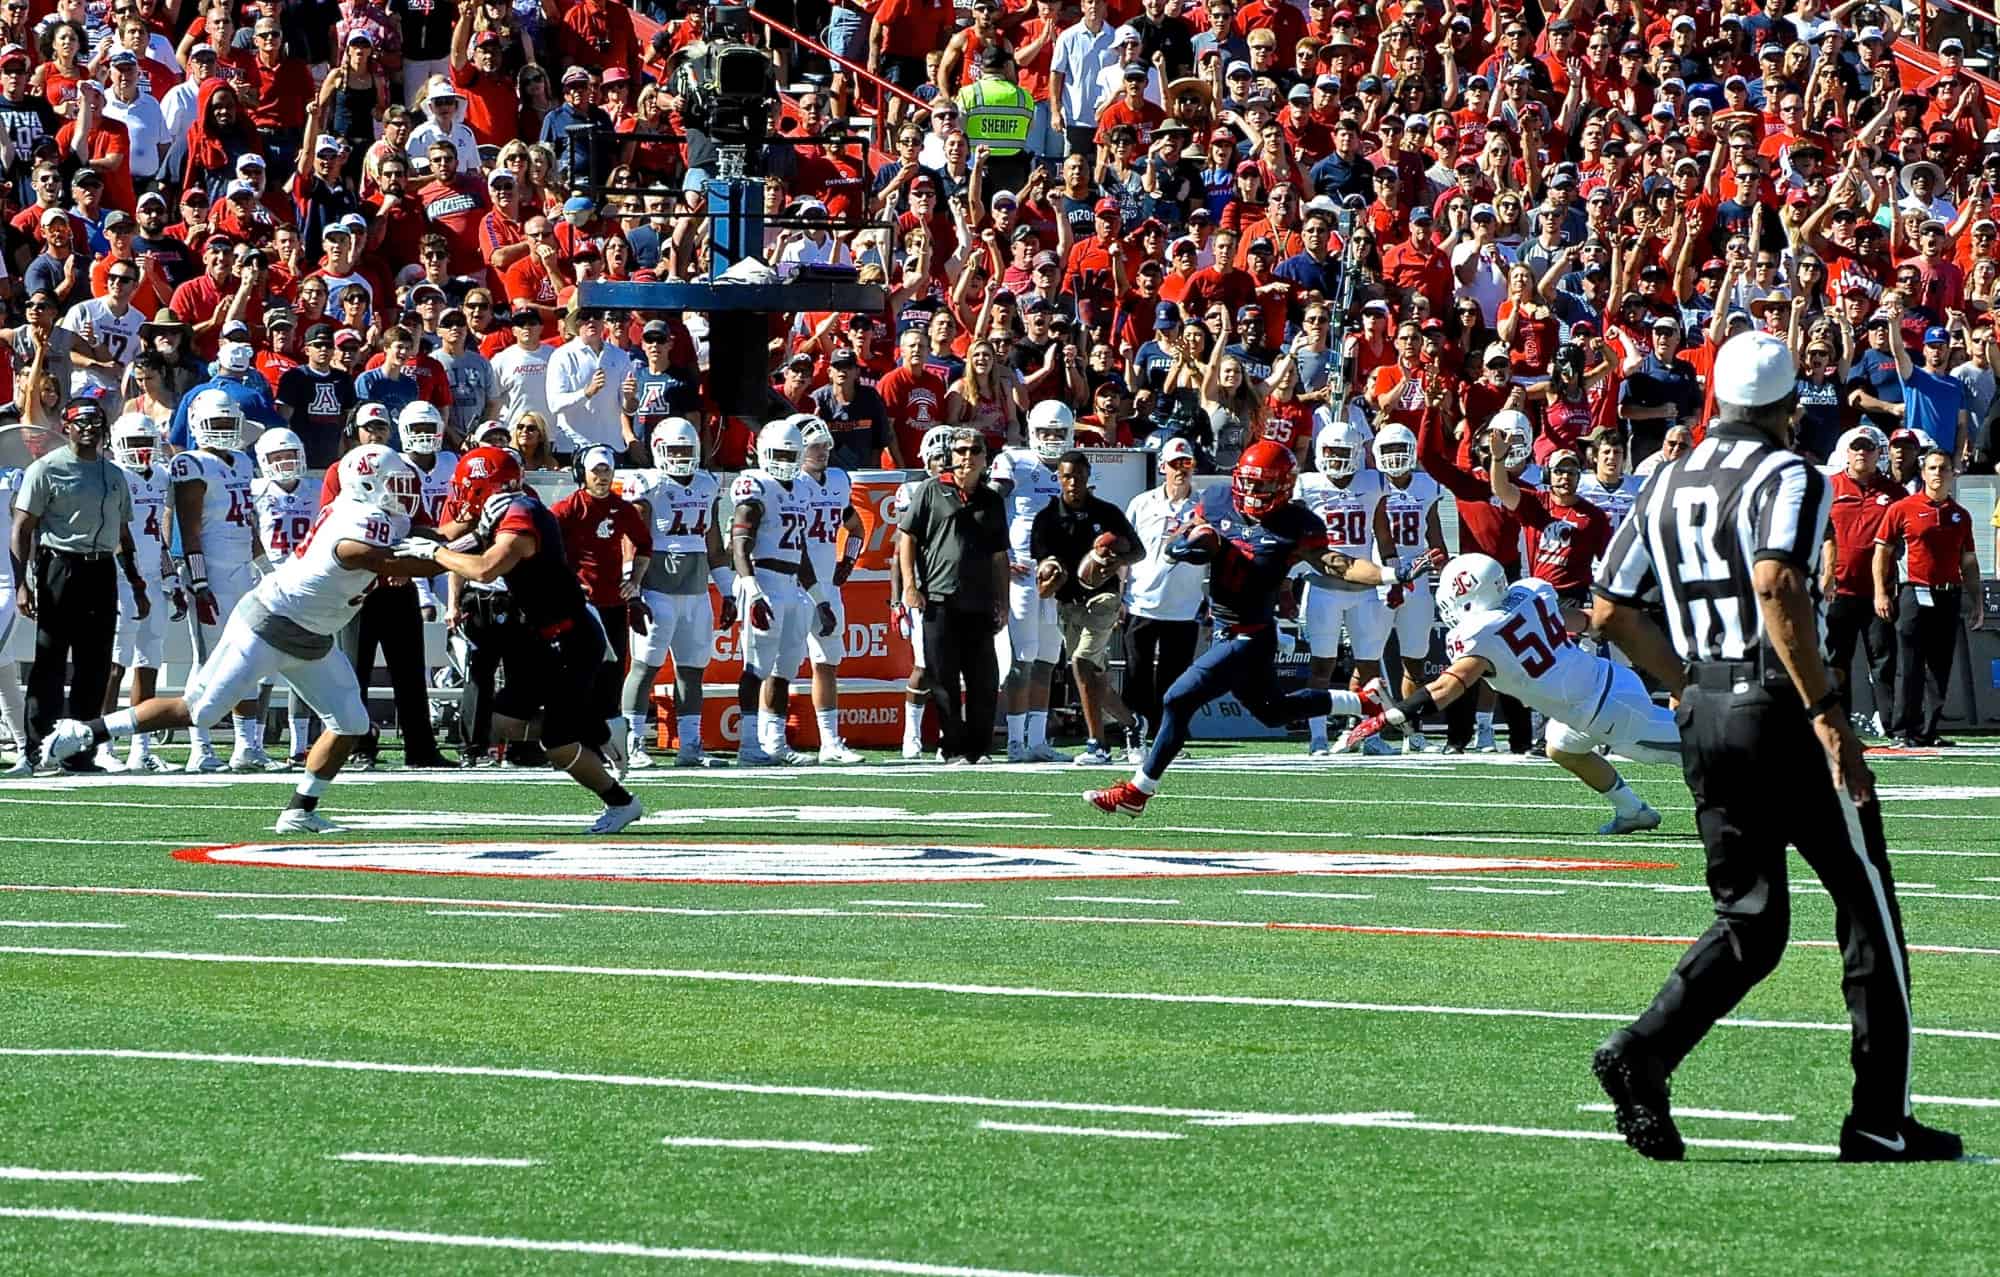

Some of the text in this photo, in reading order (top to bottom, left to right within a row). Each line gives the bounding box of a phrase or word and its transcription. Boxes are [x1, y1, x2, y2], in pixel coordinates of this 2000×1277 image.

[0, 111, 42, 127] VIVA
[981, 118, 1018, 134] SHERIFF
[308, 383, 341, 415] A
[638, 381, 670, 416] A
[171, 459, 189, 478] 45
[467, 457, 489, 479] A
[735, 480, 752, 496] 23
[143, 505, 161, 542] 4
[364, 519, 390, 545] 99
[664, 509, 707, 537] 44
[808, 507, 842, 544] 43
[1326, 510, 1366, 546] 30
[1673, 484, 1731, 583] R
[1494, 594, 1573, 679] 54
[839, 707, 898, 724] TORADE
